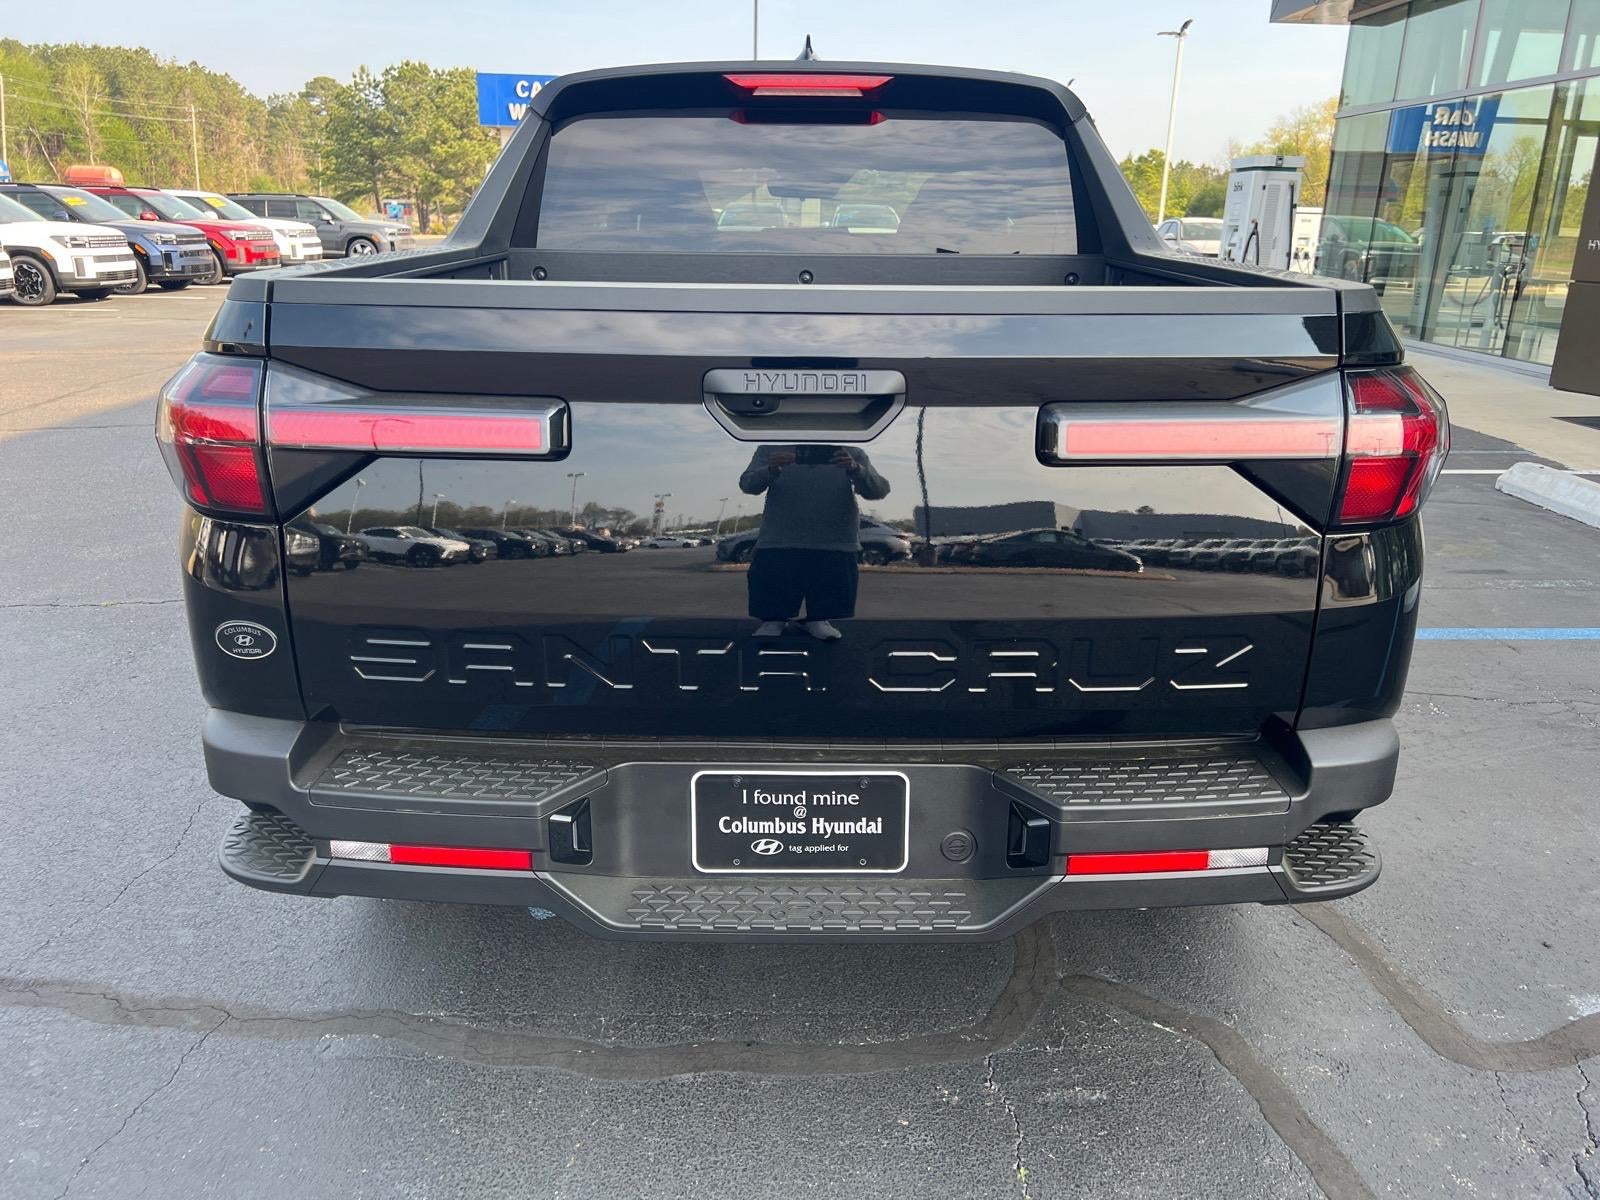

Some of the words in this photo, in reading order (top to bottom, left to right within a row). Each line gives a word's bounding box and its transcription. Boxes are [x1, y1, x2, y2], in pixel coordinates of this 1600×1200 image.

[516, 80, 551, 98] CA
[508, 103, 530, 121] W
[744, 373, 867, 392] HYUNDAI
[224, 626, 262, 636] COLUMBUS
[350, 626, 829, 693] SANTA
[866, 634, 1255, 694] CRUZ
[742, 789, 747, 804] I
[754, 789, 806, 806] found
[813, 790, 860, 806] mine
[793, 805, 807, 819] @
[718, 816, 806, 834] Columbus
[812, 817, 882, 838] Hyundai
[789, 845, 803, 854] tag
[804, 844, 835, 853] applied
[837, 844, 849, 852] for
